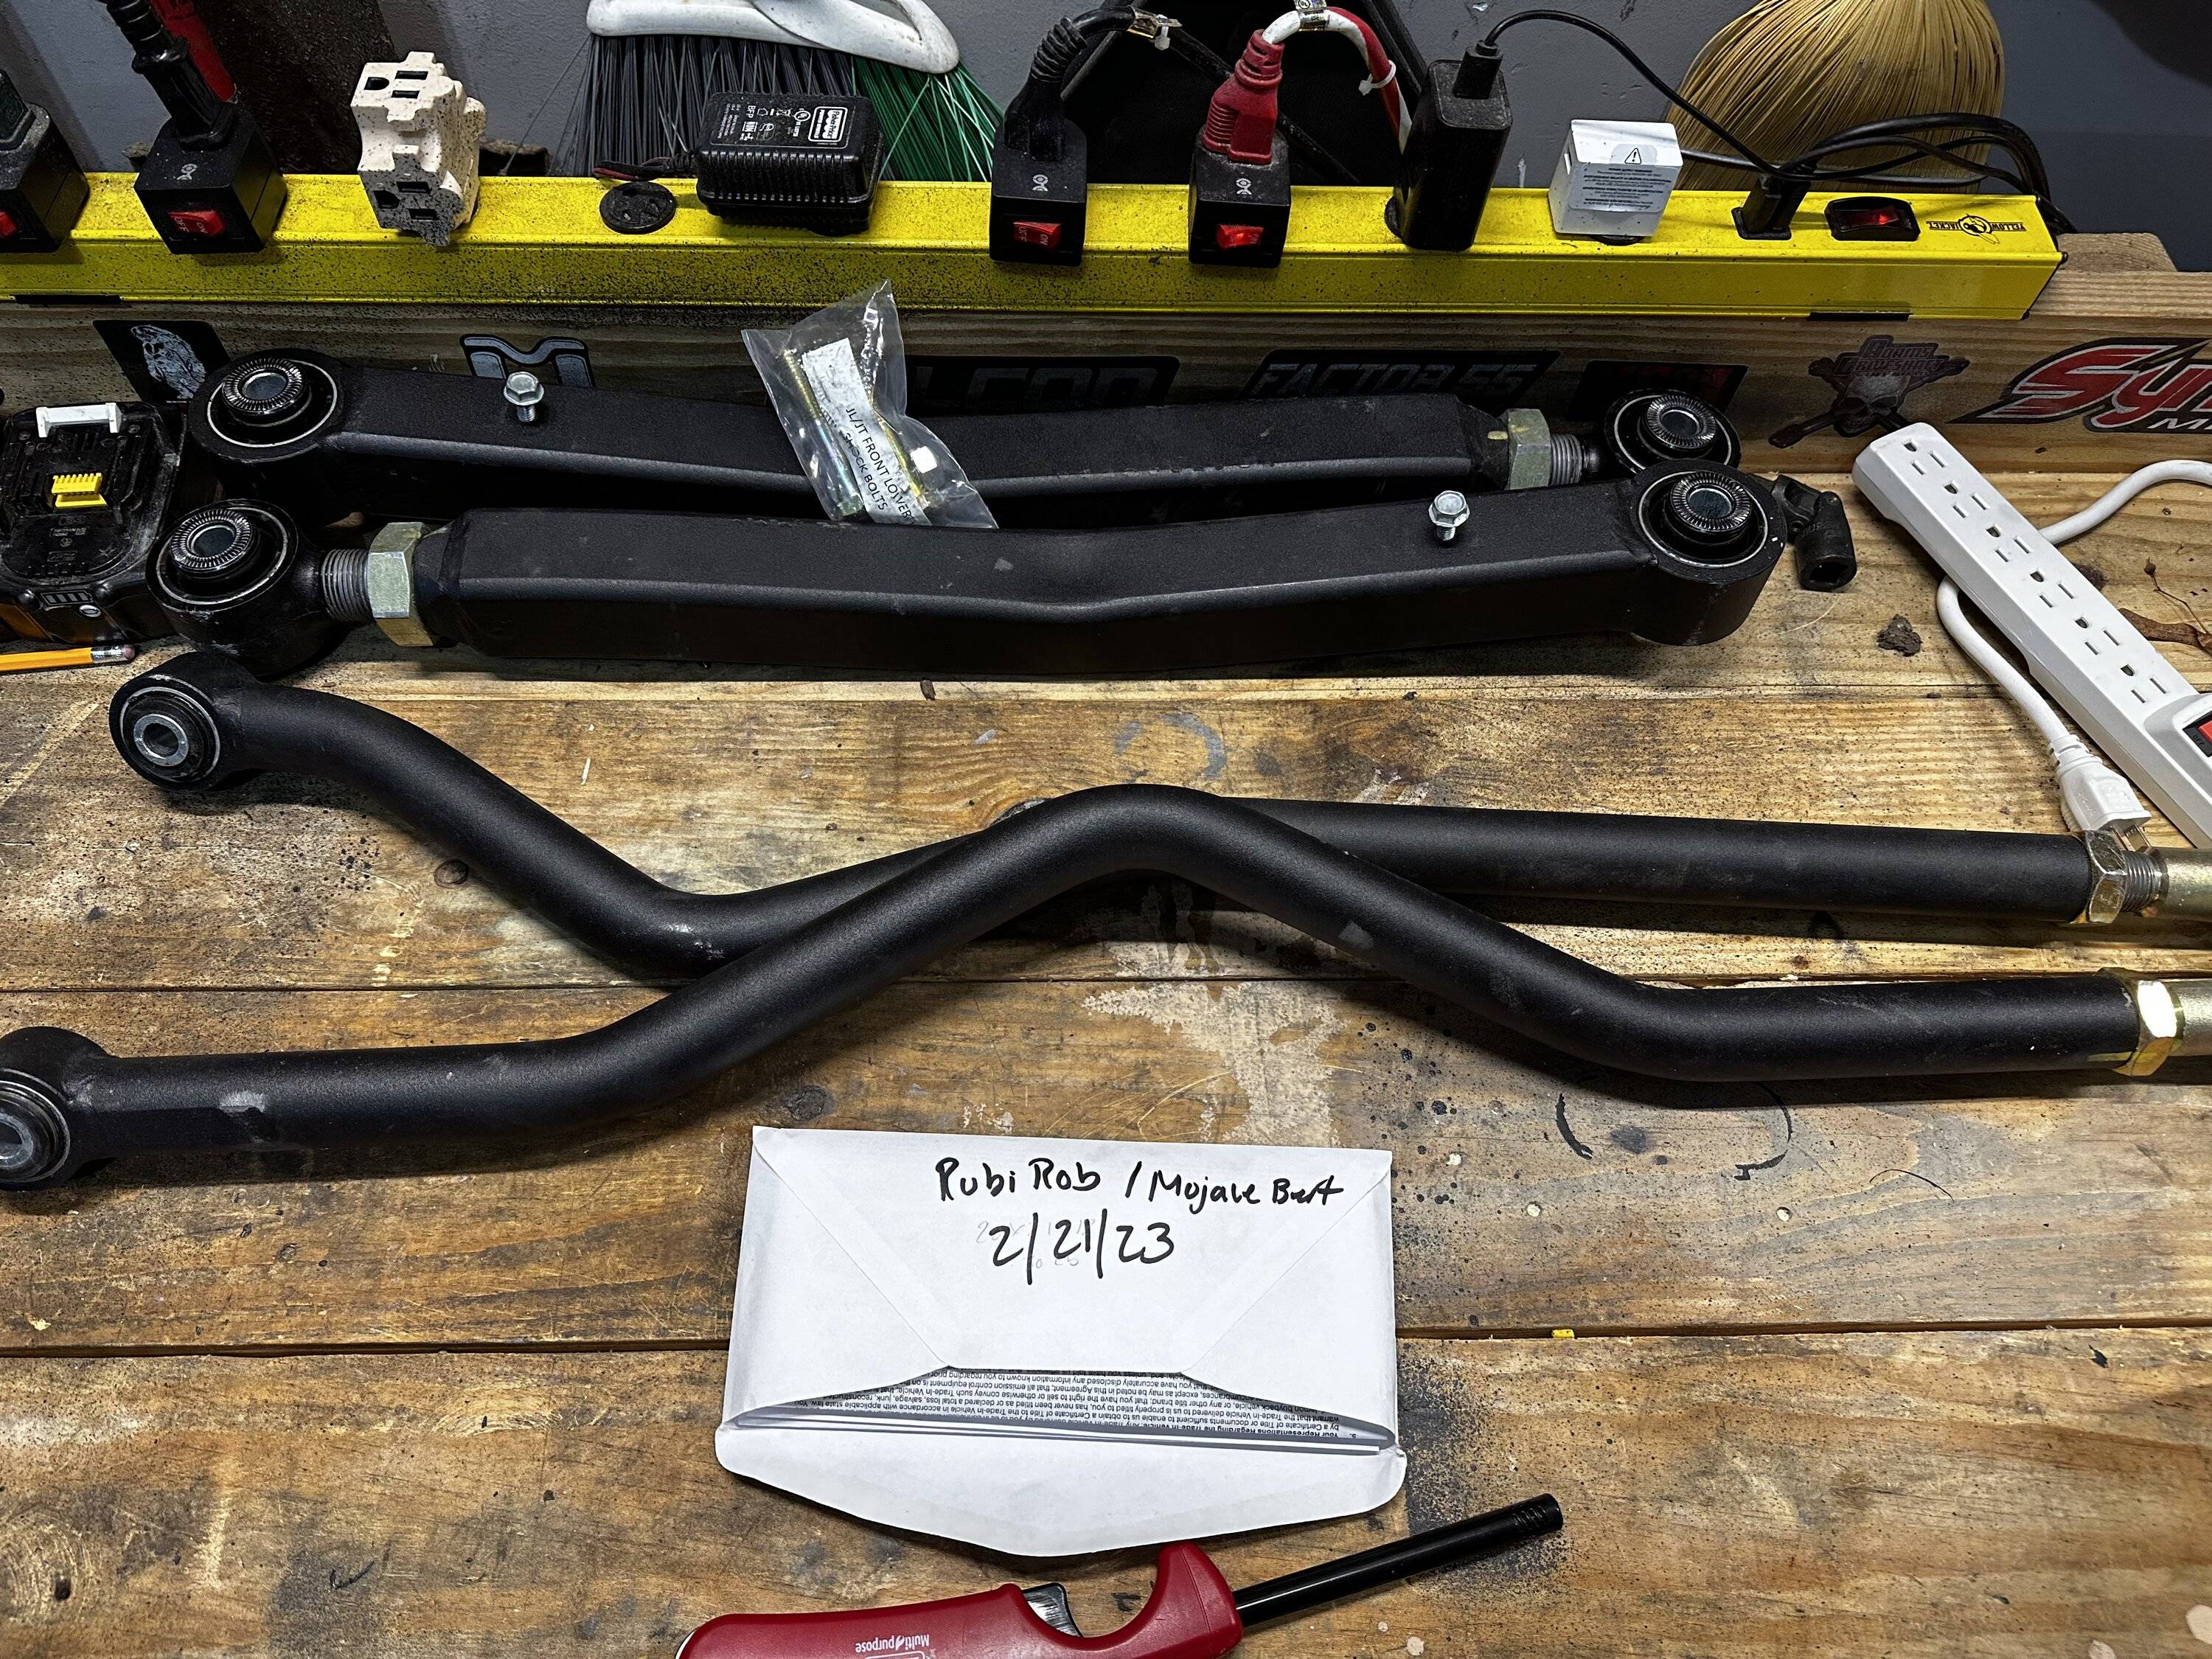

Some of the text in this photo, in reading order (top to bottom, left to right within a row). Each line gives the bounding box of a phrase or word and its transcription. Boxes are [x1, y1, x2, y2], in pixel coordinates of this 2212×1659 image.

[175, 217, 189, 233] OFF
[196, 222, 209, 234] ON
[1928, 222, 2026, 231] YELLOW JACKET
[1018, 224, 1027, 243] OFF
[1040, 234, 1048, 246] ON
[846, 407, 869, 434] JL/JT
[862, 437, 890, 476] FRONT
[863, 474, 888, 512] BOLTS
[1029, 1157, 1102, 1192] Rob
[988, 1208, 1175, 1285] 2/21/23
[931, 1369, 947, 1379] prior
[949, 1370, 982, 1380] regarding
[984, 1371, 996, 1380] you
[1006, 1374, 1030, 1382] known
[930, 1378, 967, 1388] equipment
[1032, 1375, 1071, 1384] information
[1073, 1375, 1085, 1383] any
[1087, 1377, 1121, 1386] disclosed
[1123, 1378, 1159, 1388] accurately
[969, 1381, 992, 1389] control
[994, 1382, 1026, 1391] emission
[1037, 1384, 1050, 1392] that
[1161, 1381, 1178, 1389] have
[1179, 1381, 1192, 1389] you
[925, 1388, 954, 1397] Trade-In
[975, 1388, 1000, 1397] convey
[1001, 1391, 1035, 1400] otherwise
[1116, 1388, 1136, 1396] noted
[1149, 1388, 1164, 1397] may
[1175, 1389, 1198, 1399] except
[874, 1394, 891, 1403] junk,
[893, 1394, 922, 1404] salvage,
[924, 1397, 940, 1405] loss,
[1069, 1393, 1085, 1402] right
[1087, 1395, 1099, 1403] the
[1100, 1396, 1118, 1404] have
[1119, 1395, 1133, 1403] you
[844, 1400, 881, 1411] applicable
[883, 1403, 897, 1411] with
[964, 1399, 995, 1408] declared
[1016, 1401, 1033, 1409] titled
[1034, 1402, 1052, 1410] been
[1090, 1402, 1105, 1411] you,
[1175, 1399, 1187, 1408] title
[1189, 1400, 1207, 1408] other
[1209, 1399, 1222, 1408] any
[1233, 1402, 1260, 1411] vehicle,
[1262, 1402, 1293, 1413] buyback
[899, 1404, 941, 1413] accordance
[950, 1406, 975, 1414] Vehicle
[977, 1408, 1006, 1416] Trade-In
[1008, 1408, 1019, 1416] the
[1116, 1405, 1133, 1413] titled
[1135, 1405, 1164, 1415] properly
[1054, 1411, 1091, 1419] Certificate
[1098, 1413, 1121, 1421] obtain
[1192, 1409, 1224, 1418] delivered
[1225, 1411, 1251, 1419] Vehicle
[1253, 1412, 1281, 1421] Trade-In
[1284, 1413, 1295, 1422] the
[1297, 1414, 1311, 1422] that
[1141, 1415, 1166, 1423] enable
[1177, 1416, 1208, 1425] sufficient
[1209, 1418, 1249, 1427] documents
[1312, 1415, 1338, 1423] warrant
[1260, 1420, 1274, 1428] Title
[1285, 1422, 1322, 1430] Certificate
[855, 1633, 930, 1653] Multi purpose
